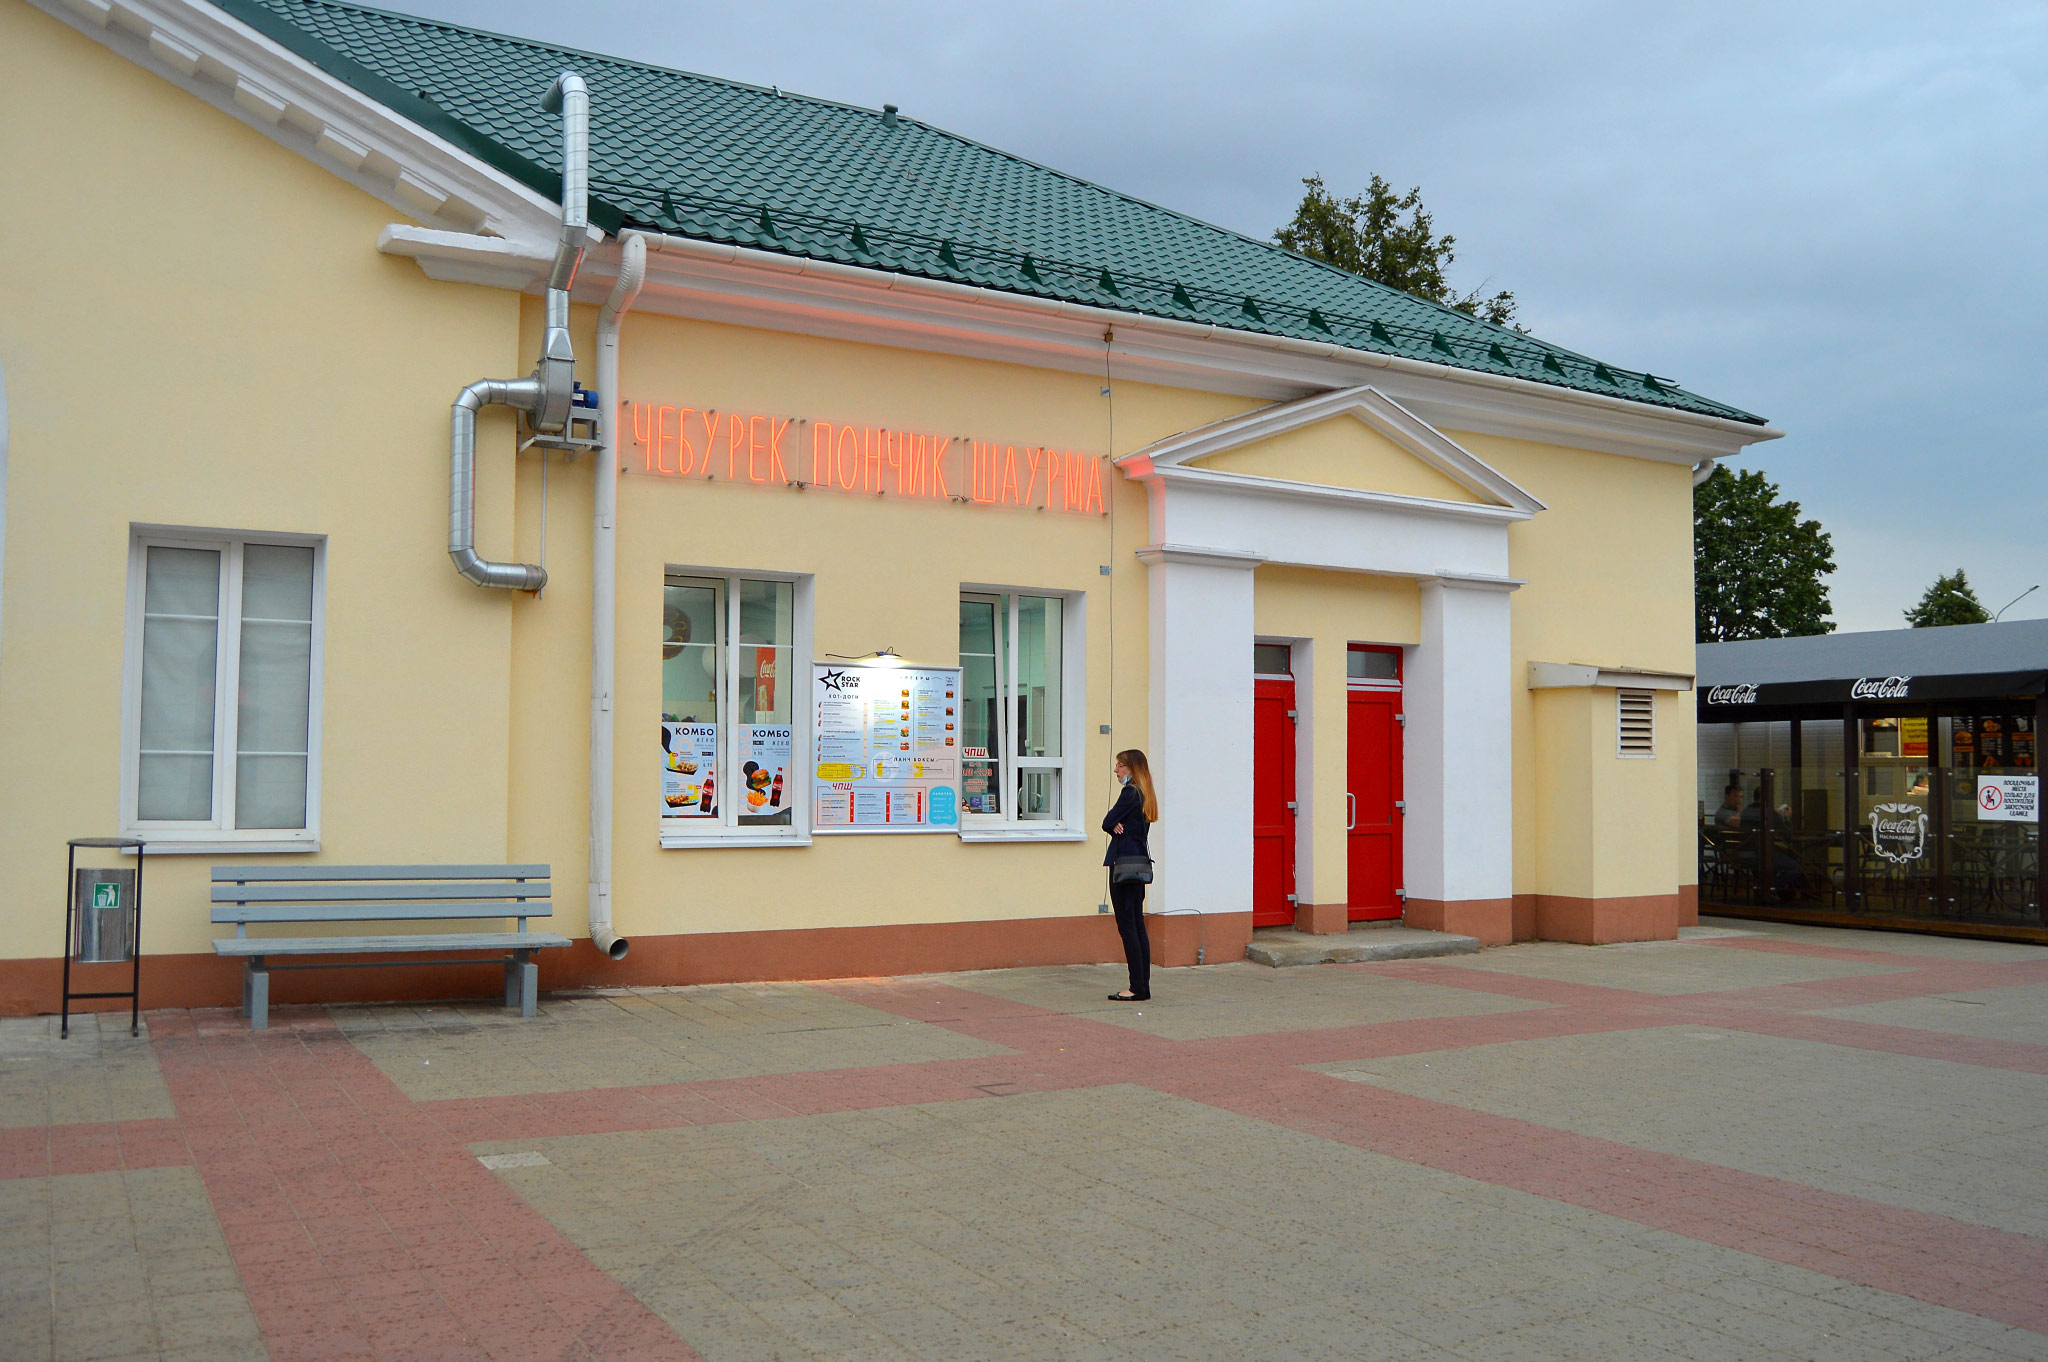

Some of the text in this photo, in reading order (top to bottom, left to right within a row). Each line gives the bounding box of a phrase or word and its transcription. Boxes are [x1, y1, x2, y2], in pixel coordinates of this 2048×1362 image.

[633, 402, 1105, 514] ЧЕБУРЕК ПОНЧИК ШАУРМА
[1707, 683, 1760, 705] Coca-Cola
[1851, 675, 1912, 699] Coca-Cola
[675, 727, 714, 736] КОМБО
[752, 729, 790, 738] КОМБО
[964, 748, 986, 757] ЧПШ
[1879, 818, 1917, 833] Coca-Cola
